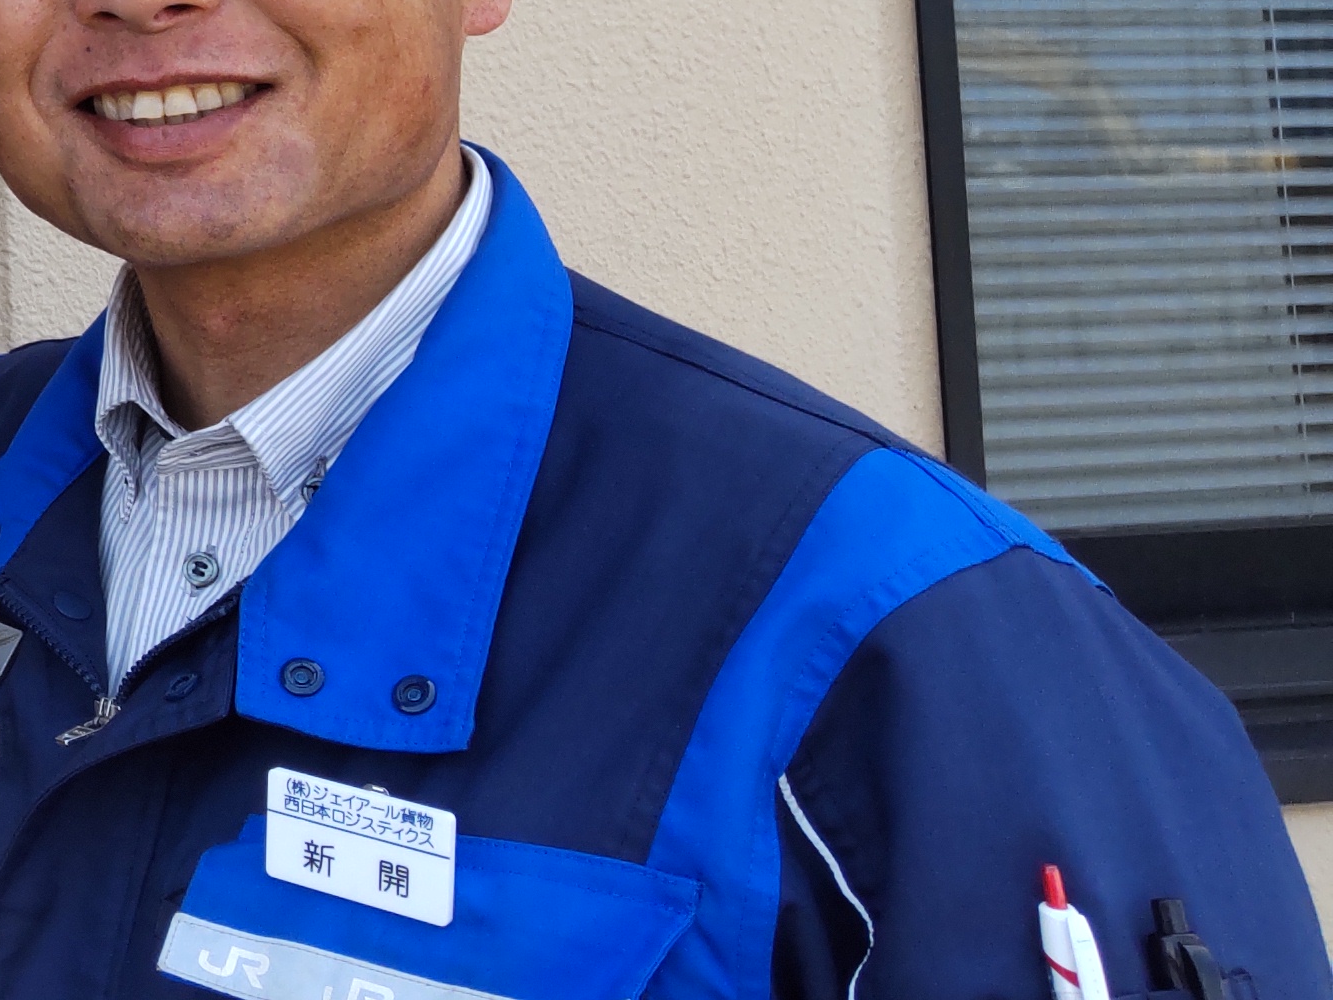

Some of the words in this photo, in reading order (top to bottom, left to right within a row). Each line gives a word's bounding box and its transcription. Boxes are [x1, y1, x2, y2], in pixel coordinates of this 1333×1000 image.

[284, 794, 435, 849] 西日本ロジスティクス
[198, 946, 270, 989] JR
